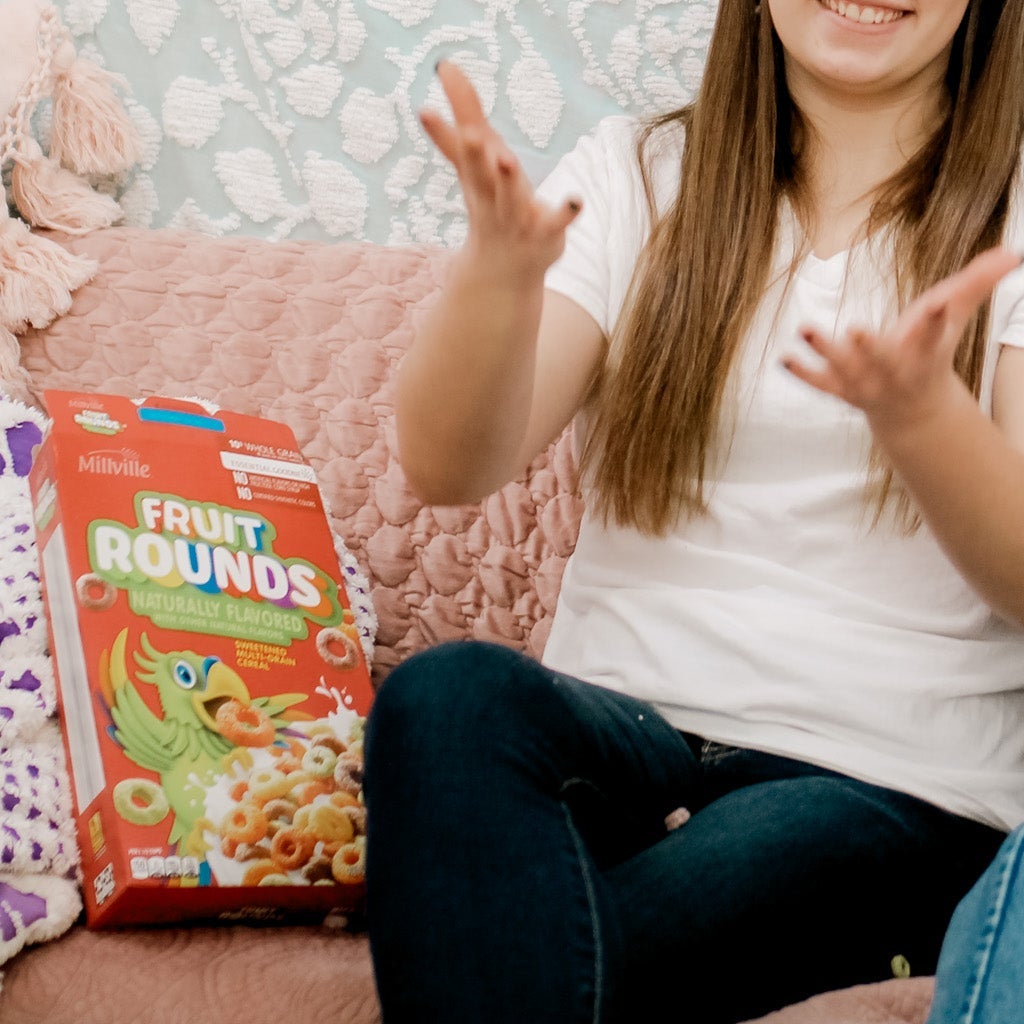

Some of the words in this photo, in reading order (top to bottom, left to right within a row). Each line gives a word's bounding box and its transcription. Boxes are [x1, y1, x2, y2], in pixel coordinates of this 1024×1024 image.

[78, 455, 151, 478] Millville
[141, 497, 263, 550] FRUIT
[94, 525, 322, 609] ROUNDS
[131, 591, 221, 618] NATURALLY
[226, 603, 303, 633] FLAVORED
